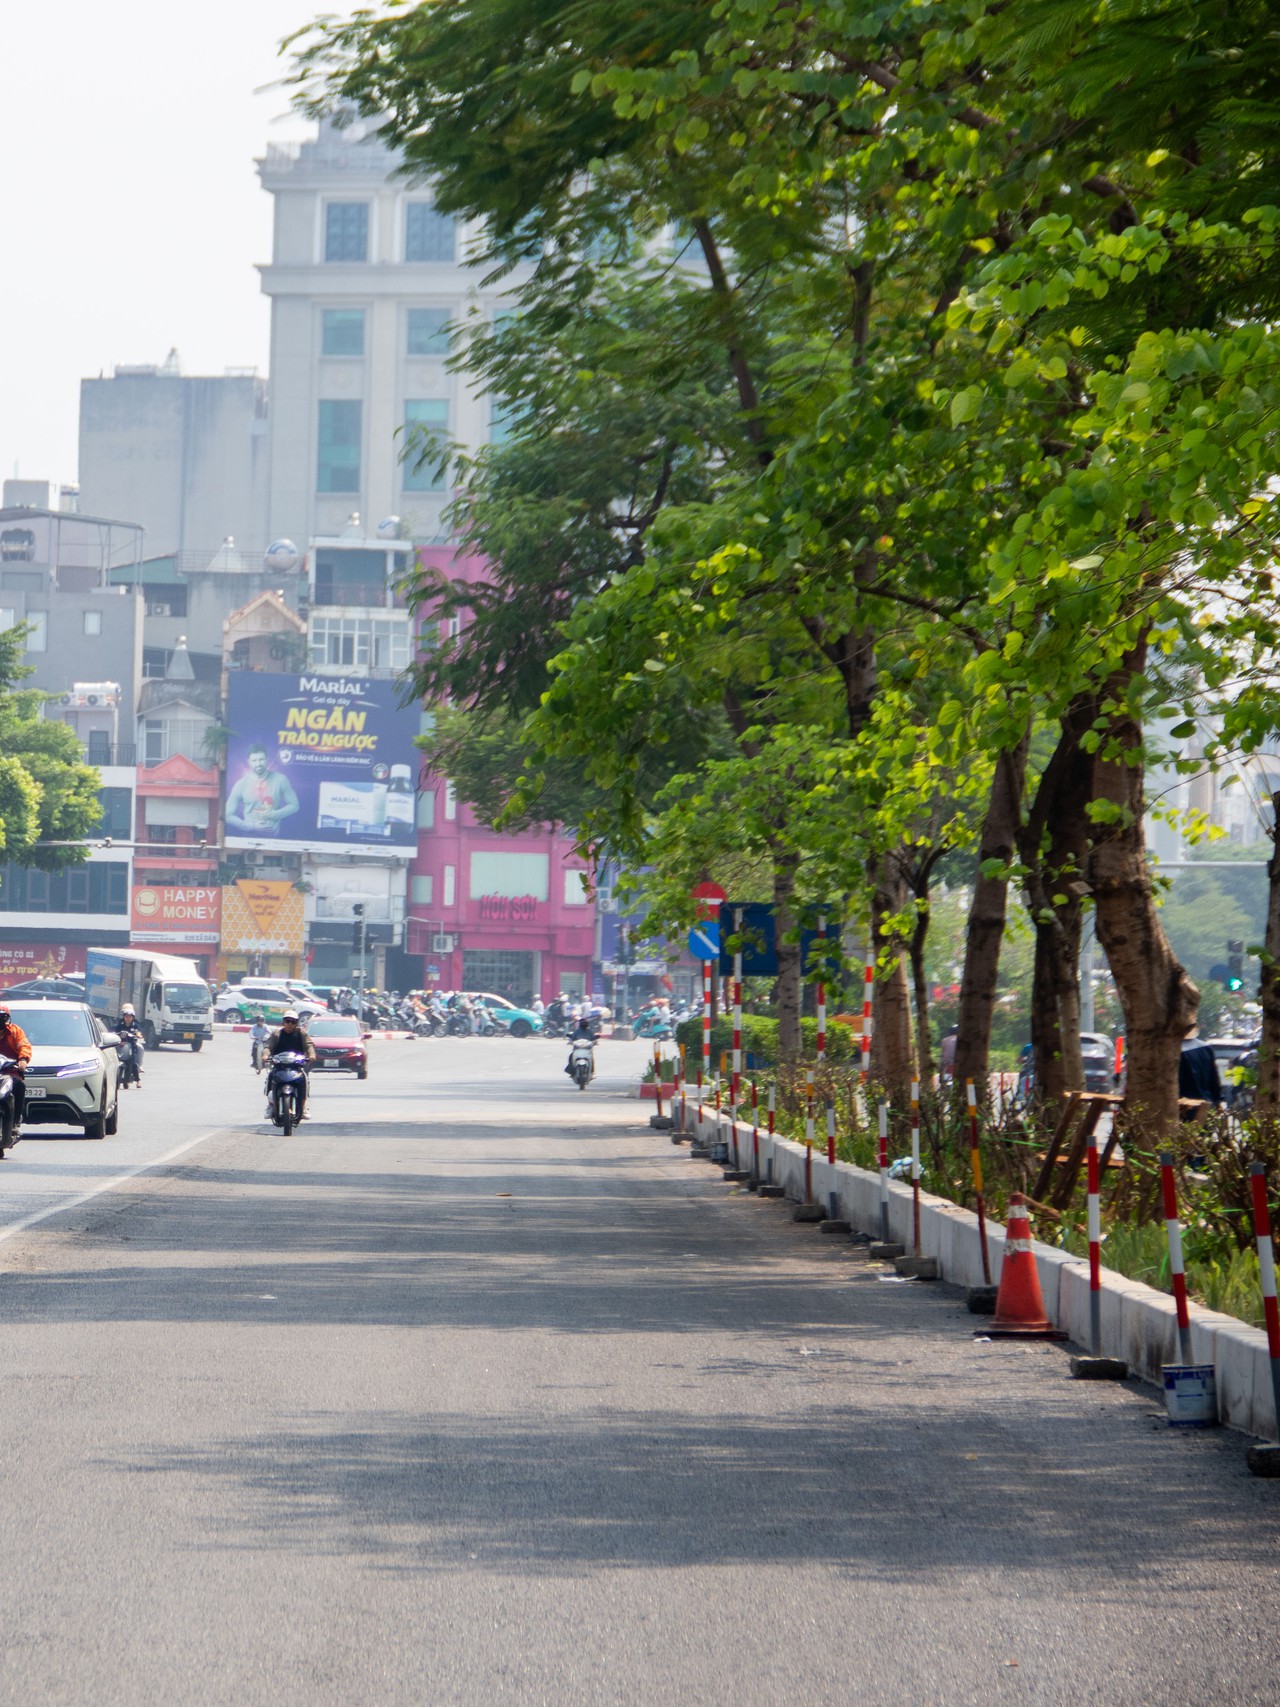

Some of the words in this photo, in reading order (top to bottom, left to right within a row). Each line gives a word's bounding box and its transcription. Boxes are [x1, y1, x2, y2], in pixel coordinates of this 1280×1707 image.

[286, 706, 367, 732] NGĂN
[278, 730, 320, 746] TRÀO
[321, 733, 378, 751] NGƯỢC
[164, 889, 216, 903] HAPPY
[482, 891, 509, 920] NÓN
[511, 894, 538, 921] SƠN
[163, 906, 217, 919] MONEY
